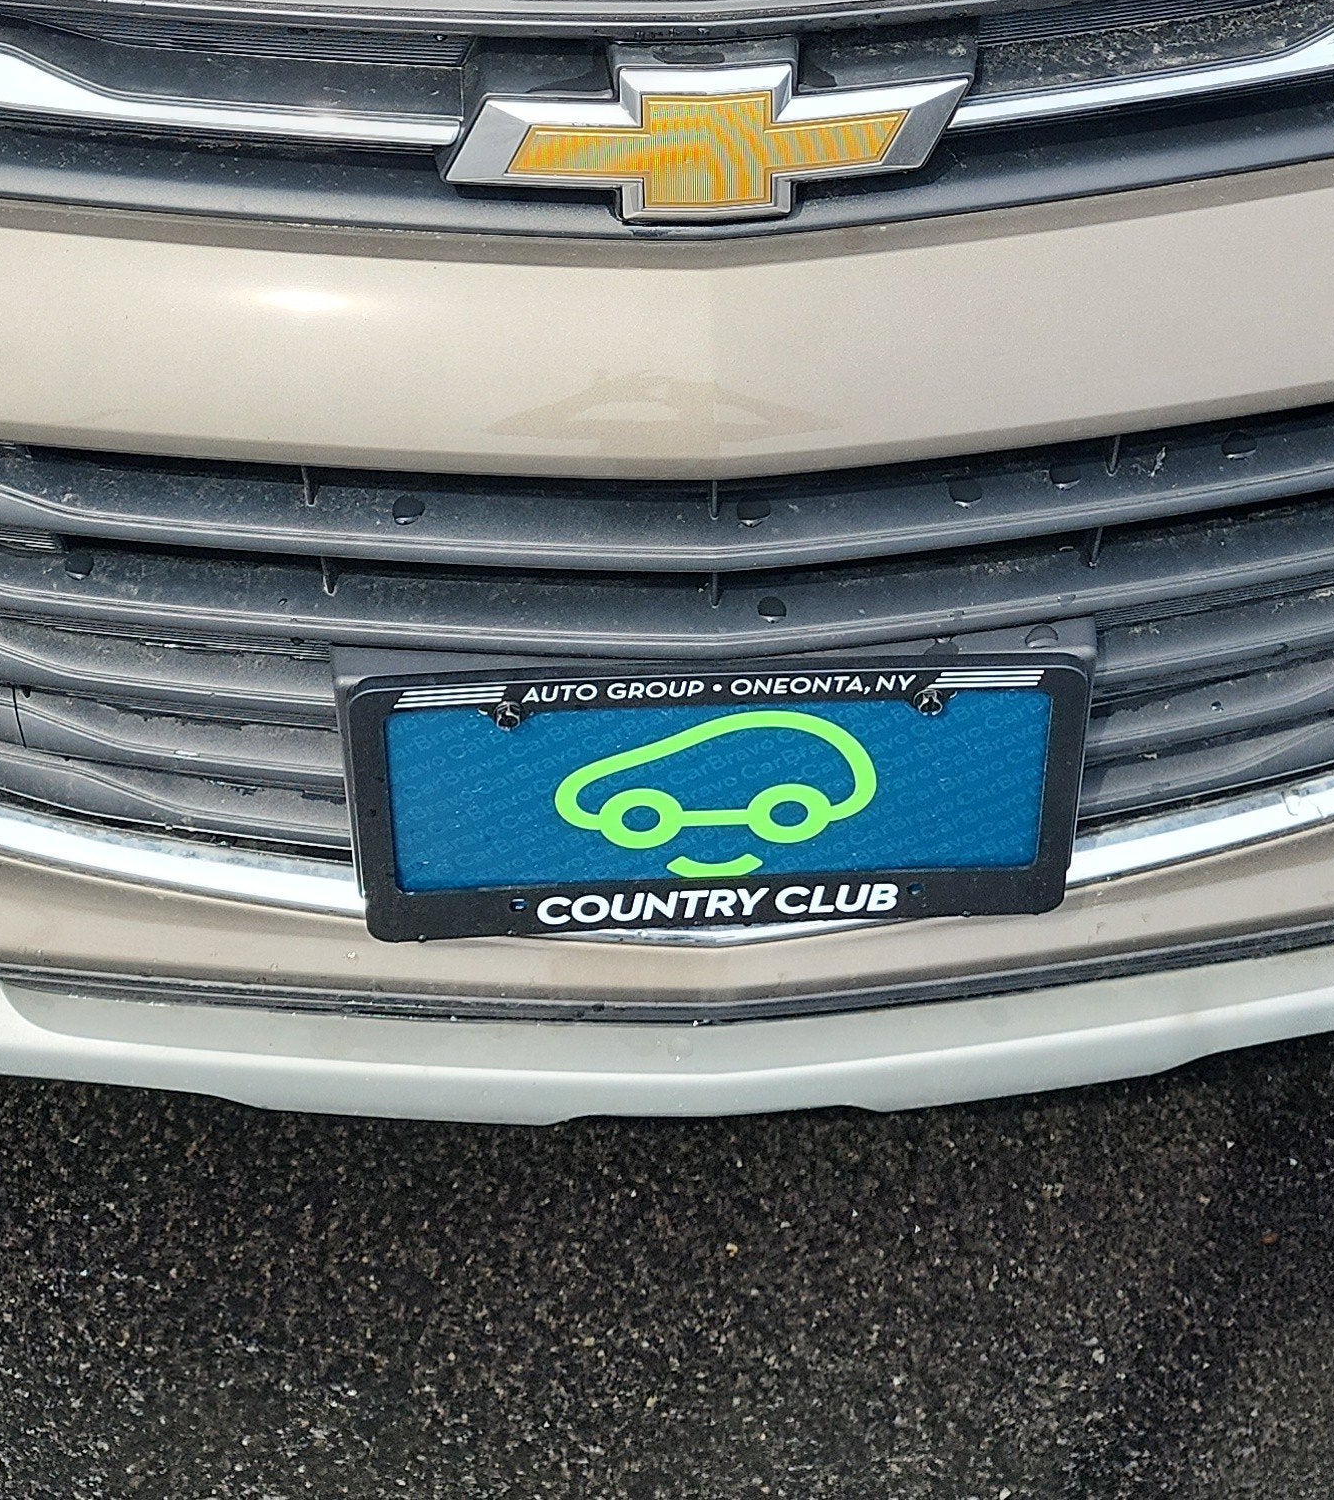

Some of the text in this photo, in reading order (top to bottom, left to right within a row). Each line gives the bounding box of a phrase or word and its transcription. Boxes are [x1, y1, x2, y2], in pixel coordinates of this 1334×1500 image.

[521, 684, 598, 703] AUTO
[606, 680, 705, 700] GROUP
[536, 883, 898, 925] COUNTRY CLUB
